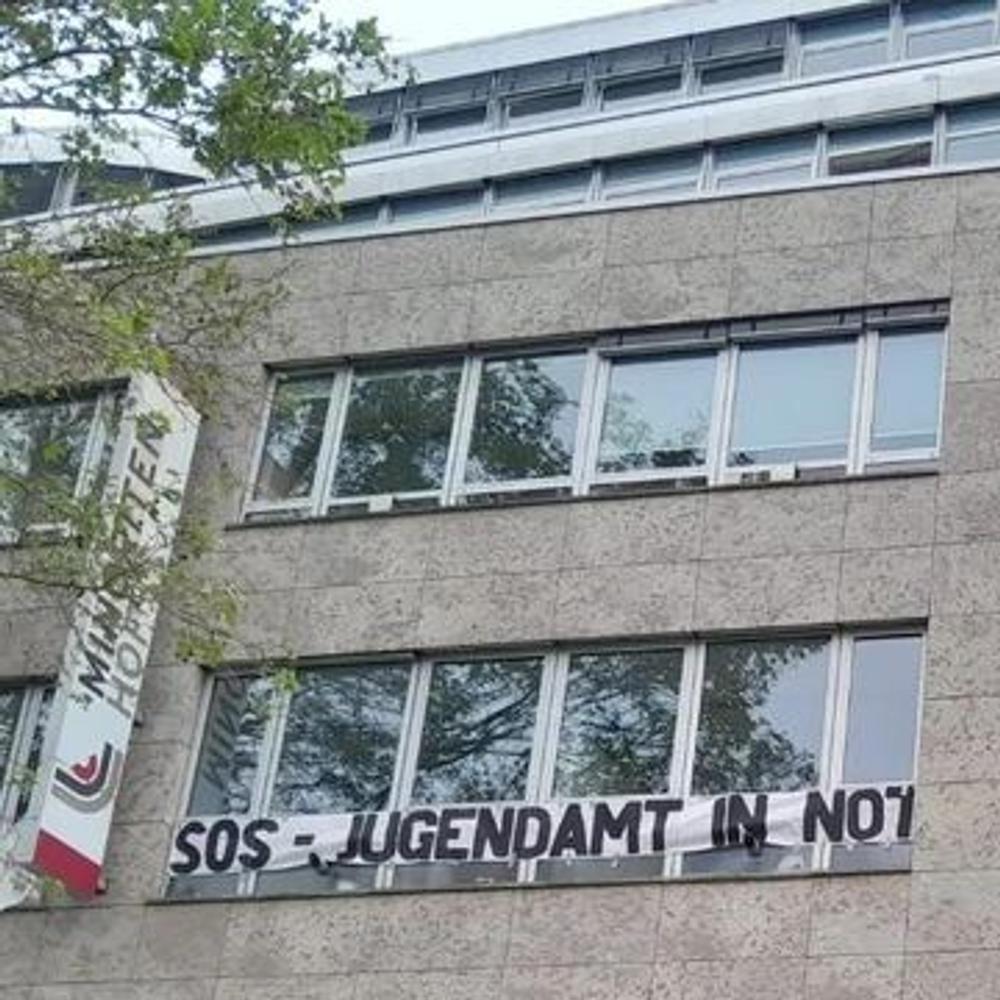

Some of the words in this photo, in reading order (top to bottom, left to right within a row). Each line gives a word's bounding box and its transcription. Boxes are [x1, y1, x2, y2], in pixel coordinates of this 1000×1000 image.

[78, 413, 166, 698] MINITEN
[171, 819, 279, 873] SOS
[338, 799, 682, 864] JUGENDAMT
[711, 794, 768, 850] IN
[803, 785, 914, 843] NOT
